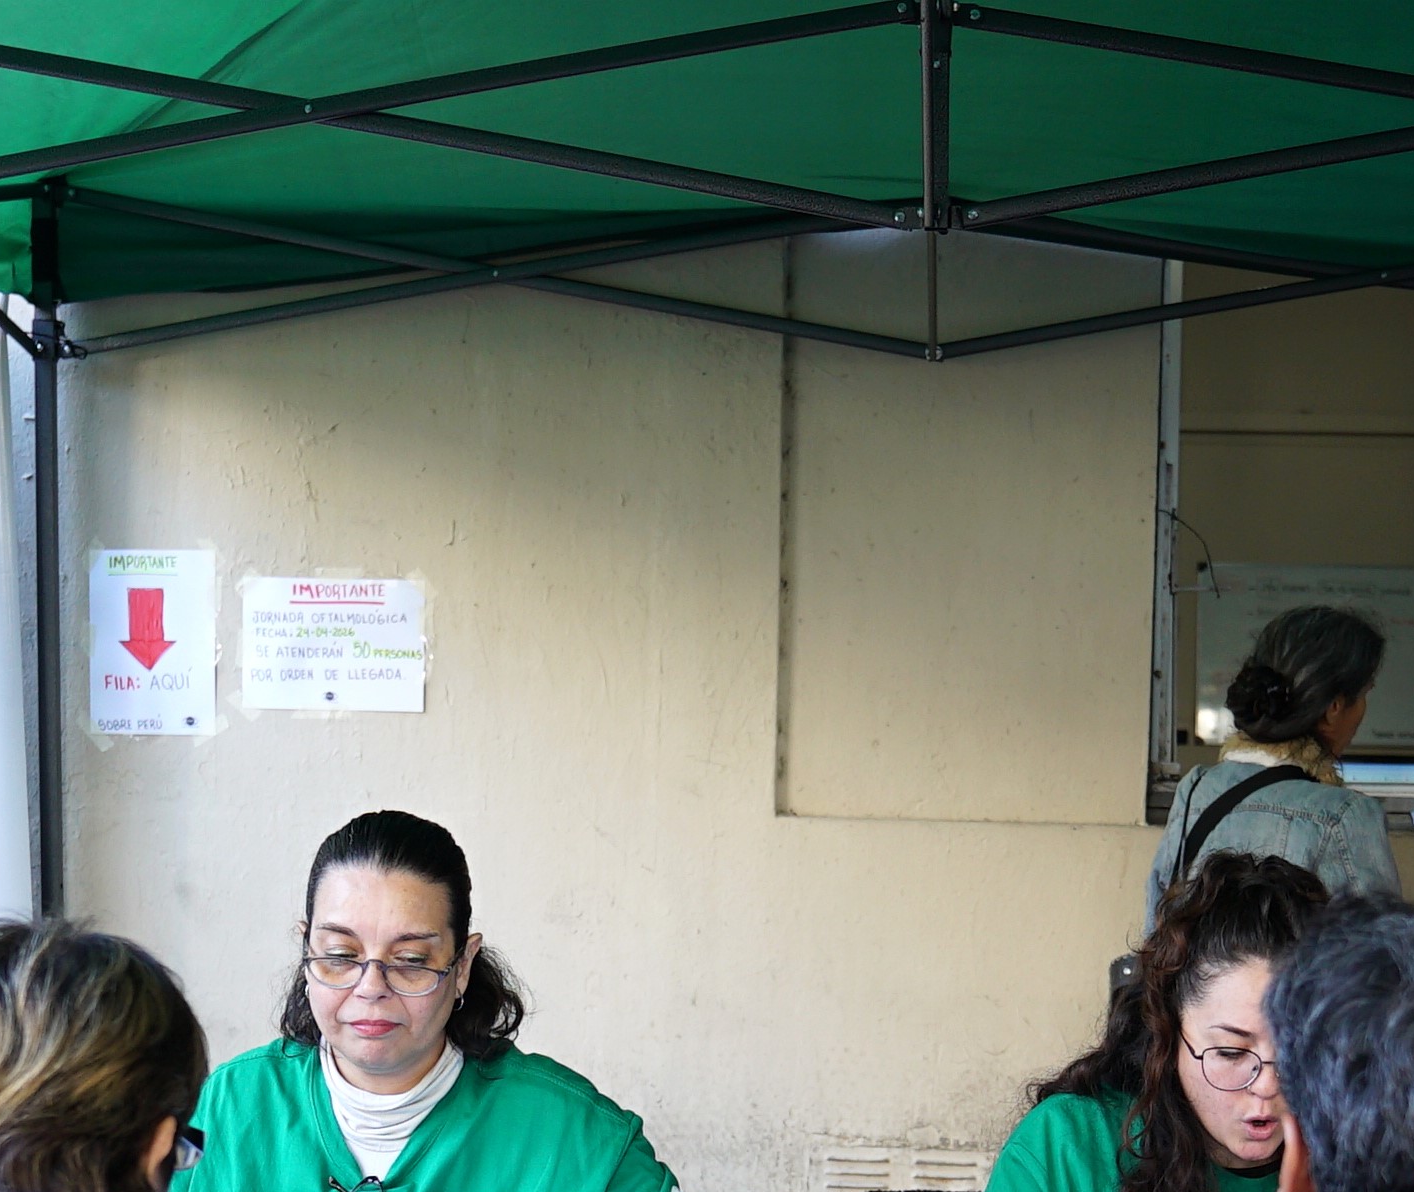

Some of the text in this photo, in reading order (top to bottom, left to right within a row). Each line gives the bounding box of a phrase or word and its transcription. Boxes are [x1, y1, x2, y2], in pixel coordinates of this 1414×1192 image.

[109, 555, 178, 571] IMPORTANTE
[292, 583, 386, 600] IMPORTANTE
[251, 611, 305, 625] JORNADA
[352, 641, 371, 659] 50
[373, 649, 424, 661] PERSONAS
[104, 666, 193, 692] FILA: AQUÍ
[250, 668, 274, 682] POR
[279, 668, 314, 682] ORDEN
[324, 669, 340, 681] DE
